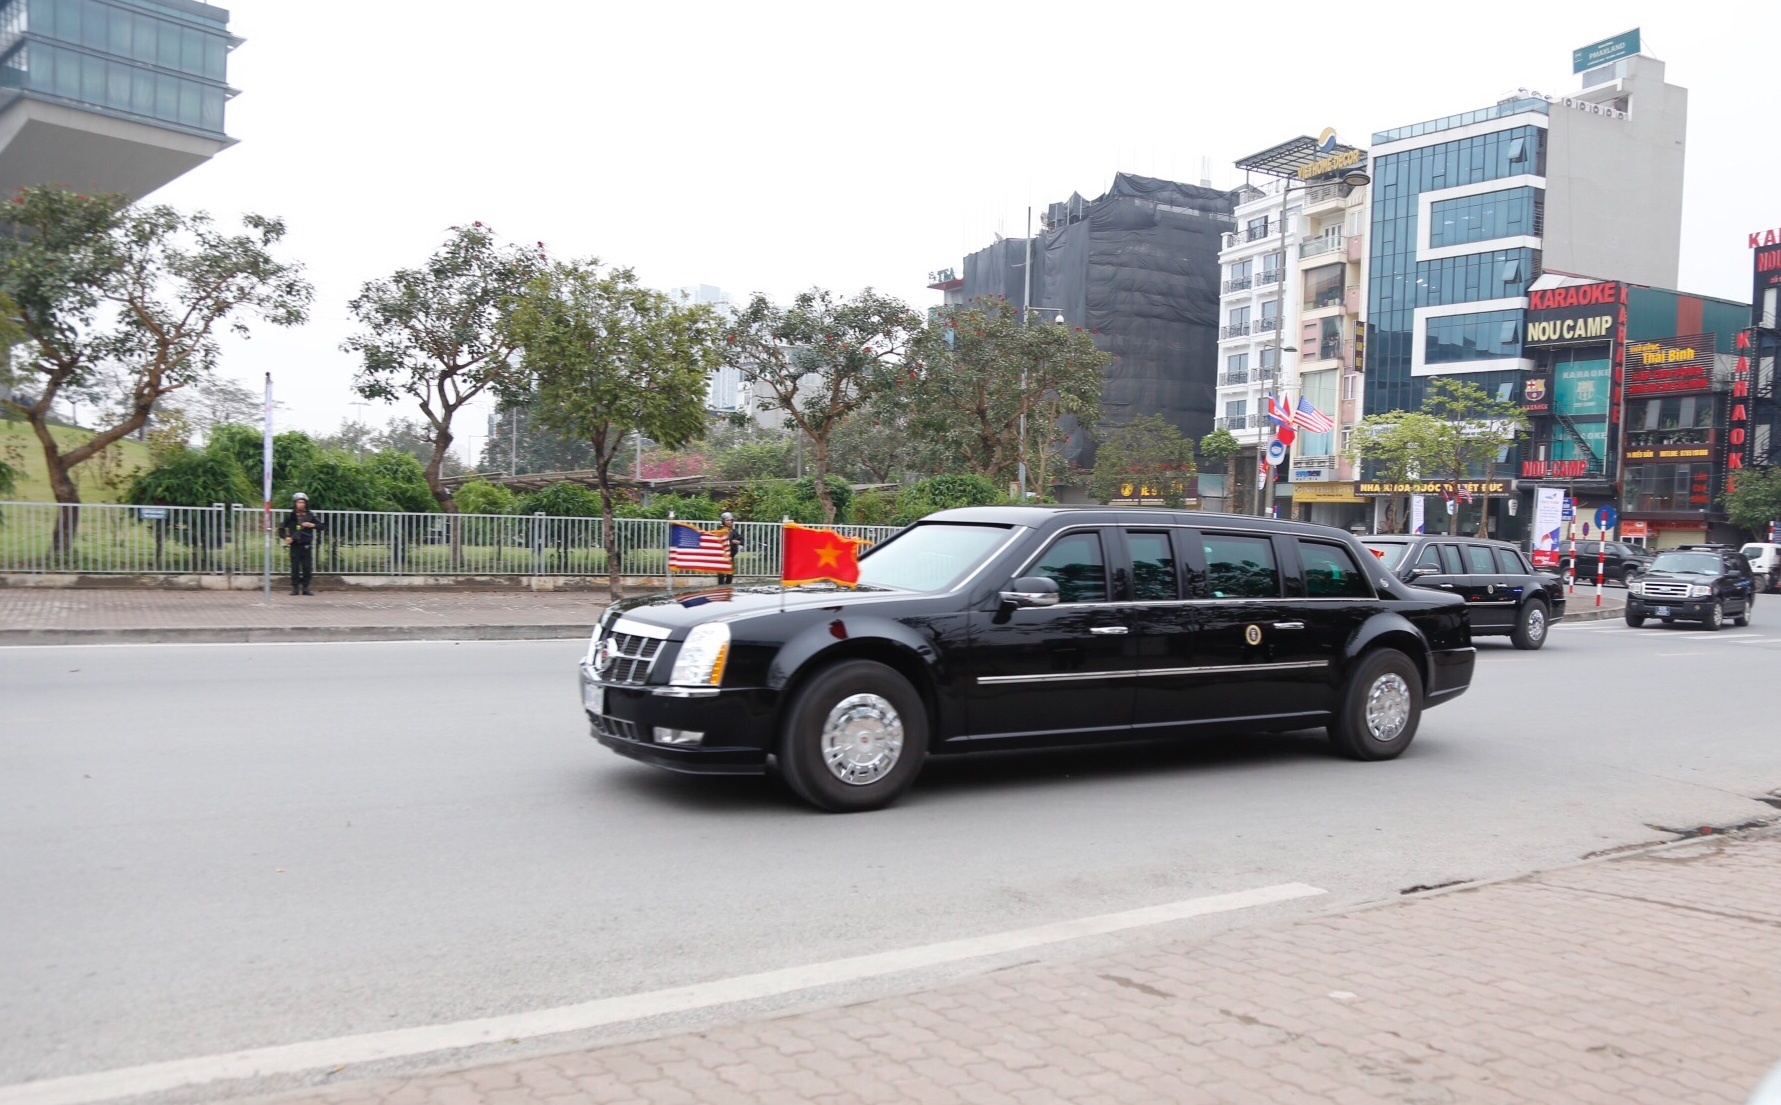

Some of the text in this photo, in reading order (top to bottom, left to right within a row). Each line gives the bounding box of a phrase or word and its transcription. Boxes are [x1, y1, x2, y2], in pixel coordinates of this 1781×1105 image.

[1748, 228, 1781, 249] KA
[1530, 281, 1617, 311] KARAOKE
[1527, 315, 1613, 342] NOU CAMP
[1612, 284, 1629, 424] KARAOKE
[1562, 369, 1610, 379] KARAOKE
[1521, 459, 1588, 477] NOU CAMP
[1360, 483, 1380, 492] NHA
